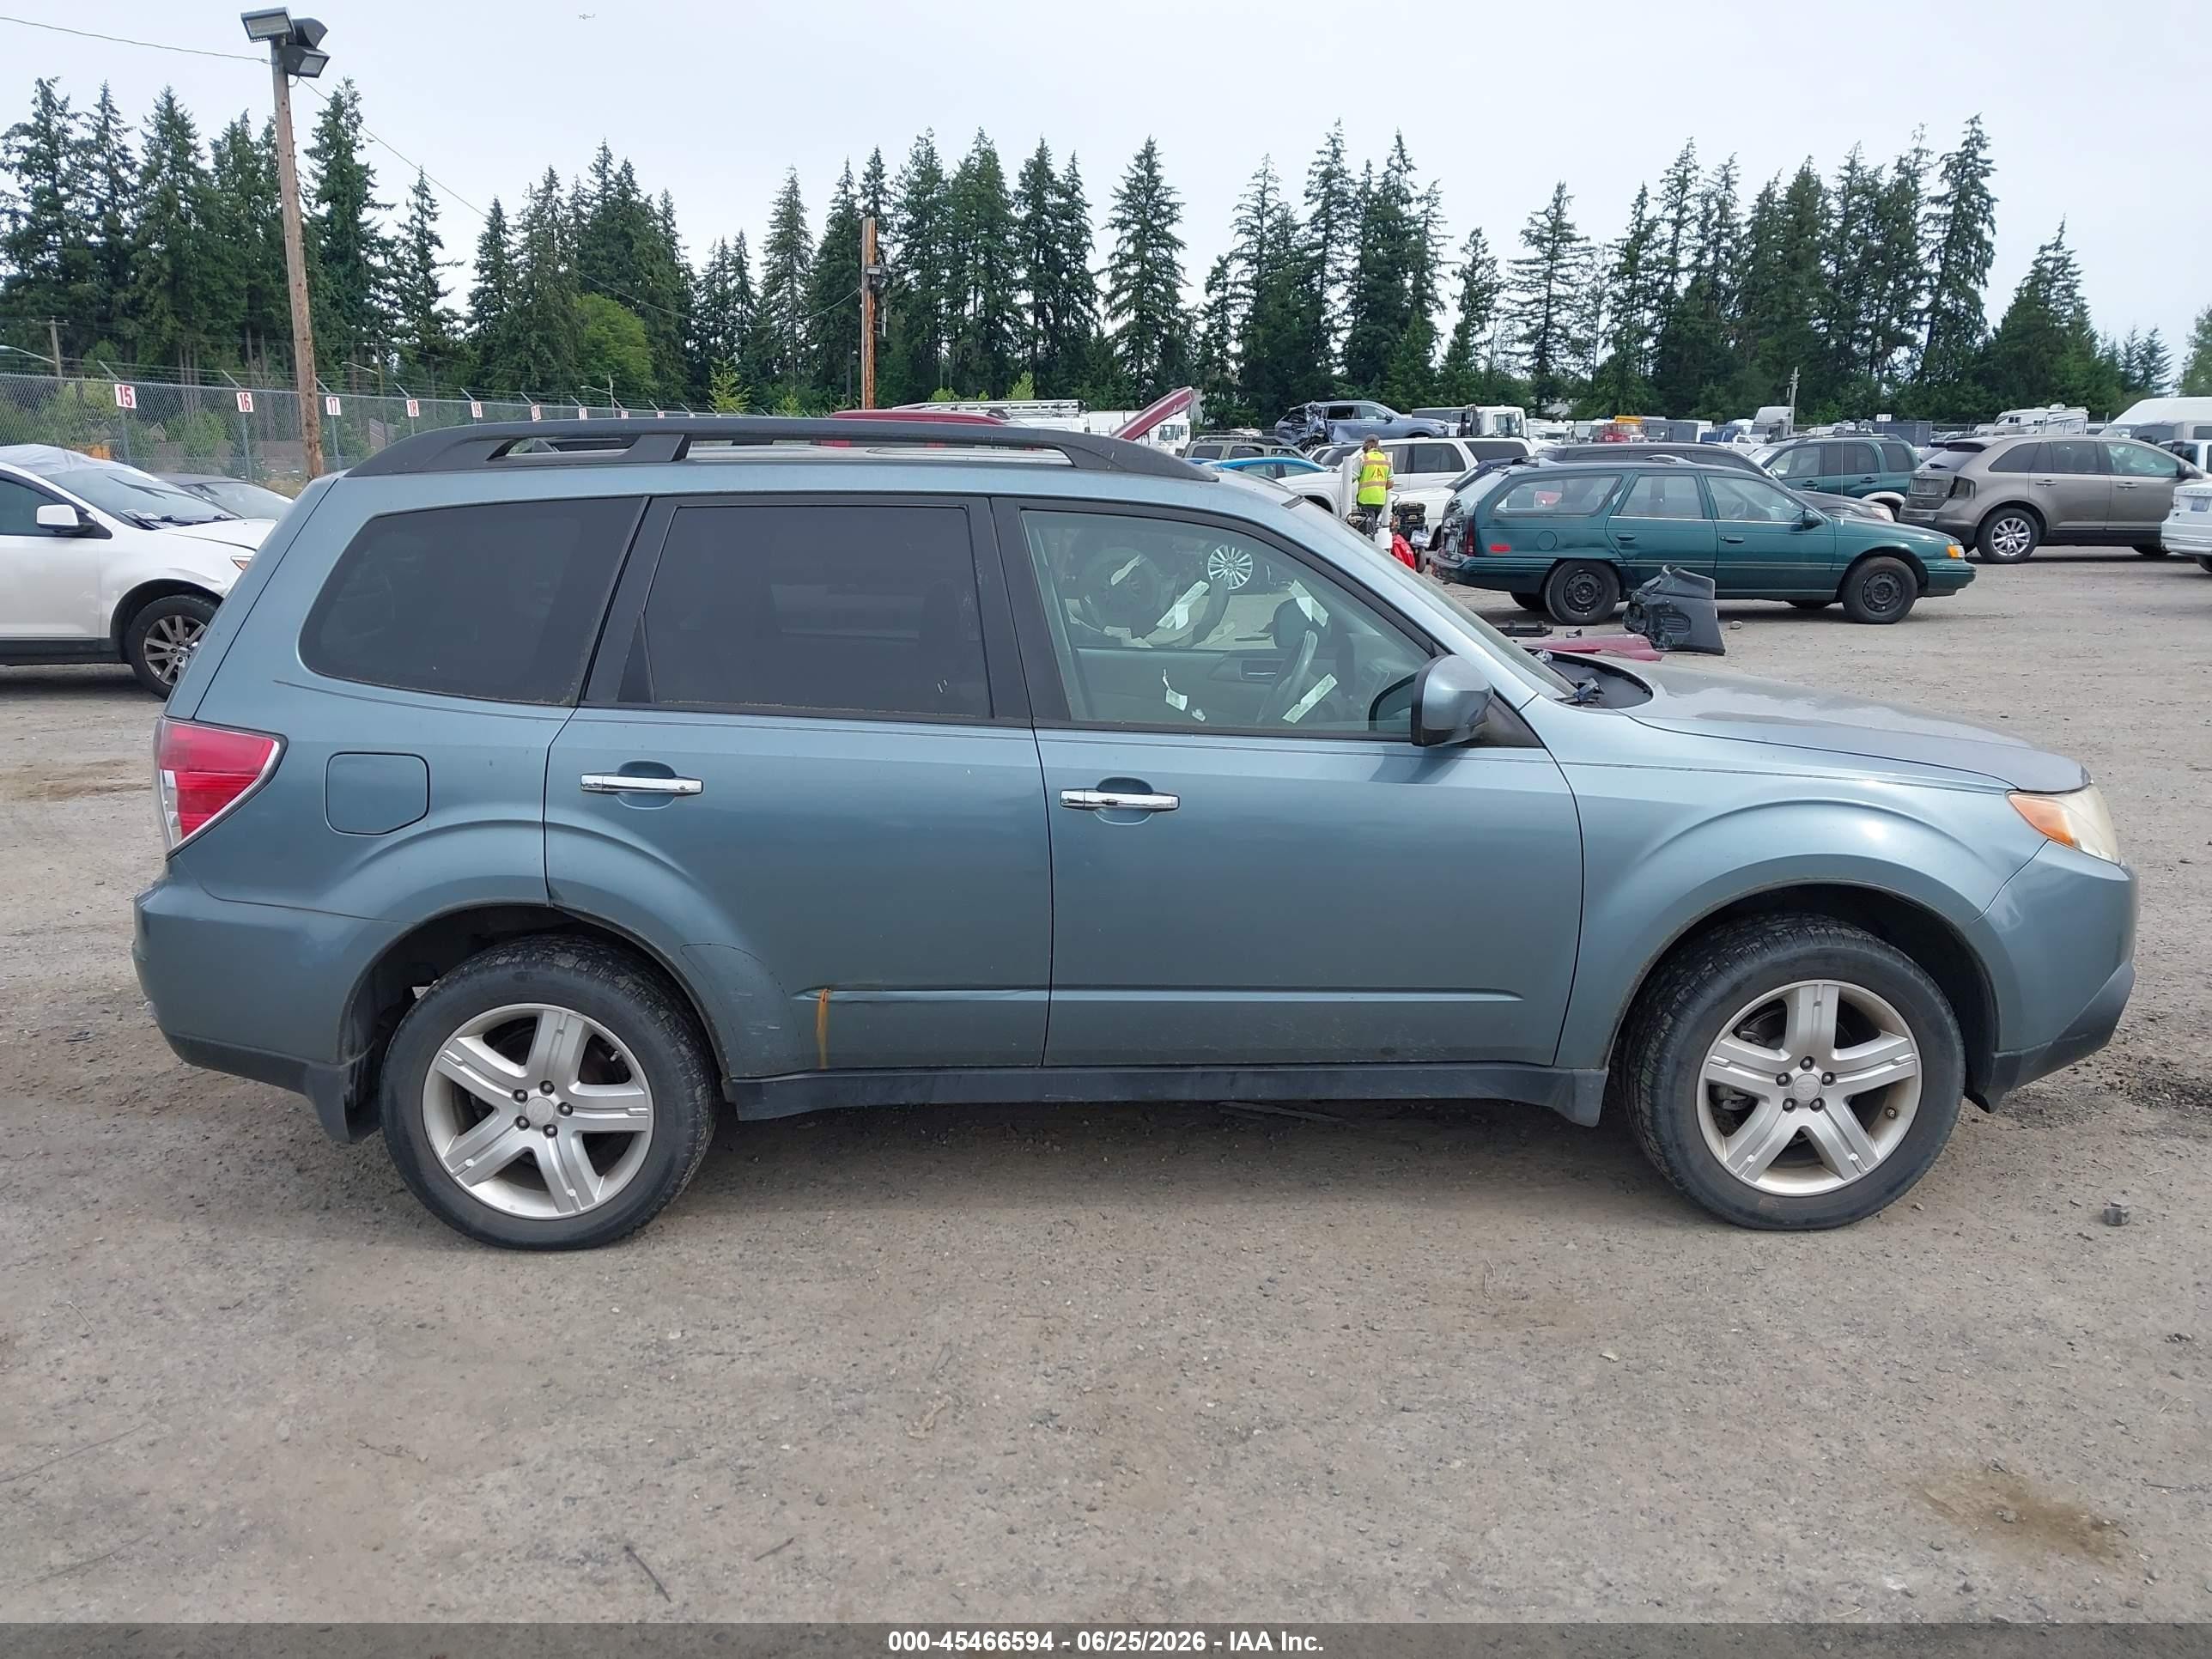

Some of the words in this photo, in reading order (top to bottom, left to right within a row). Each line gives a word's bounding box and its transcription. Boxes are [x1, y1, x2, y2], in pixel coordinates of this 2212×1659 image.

[118, 386, 133, 406] 15
[240, 394, 251, 410] 16
[328, 398, 338, 414] 17
[408, 402, 417, 416] 18
[473, 404, 481, 416] 19
[532, 406, 540, 419] 20
